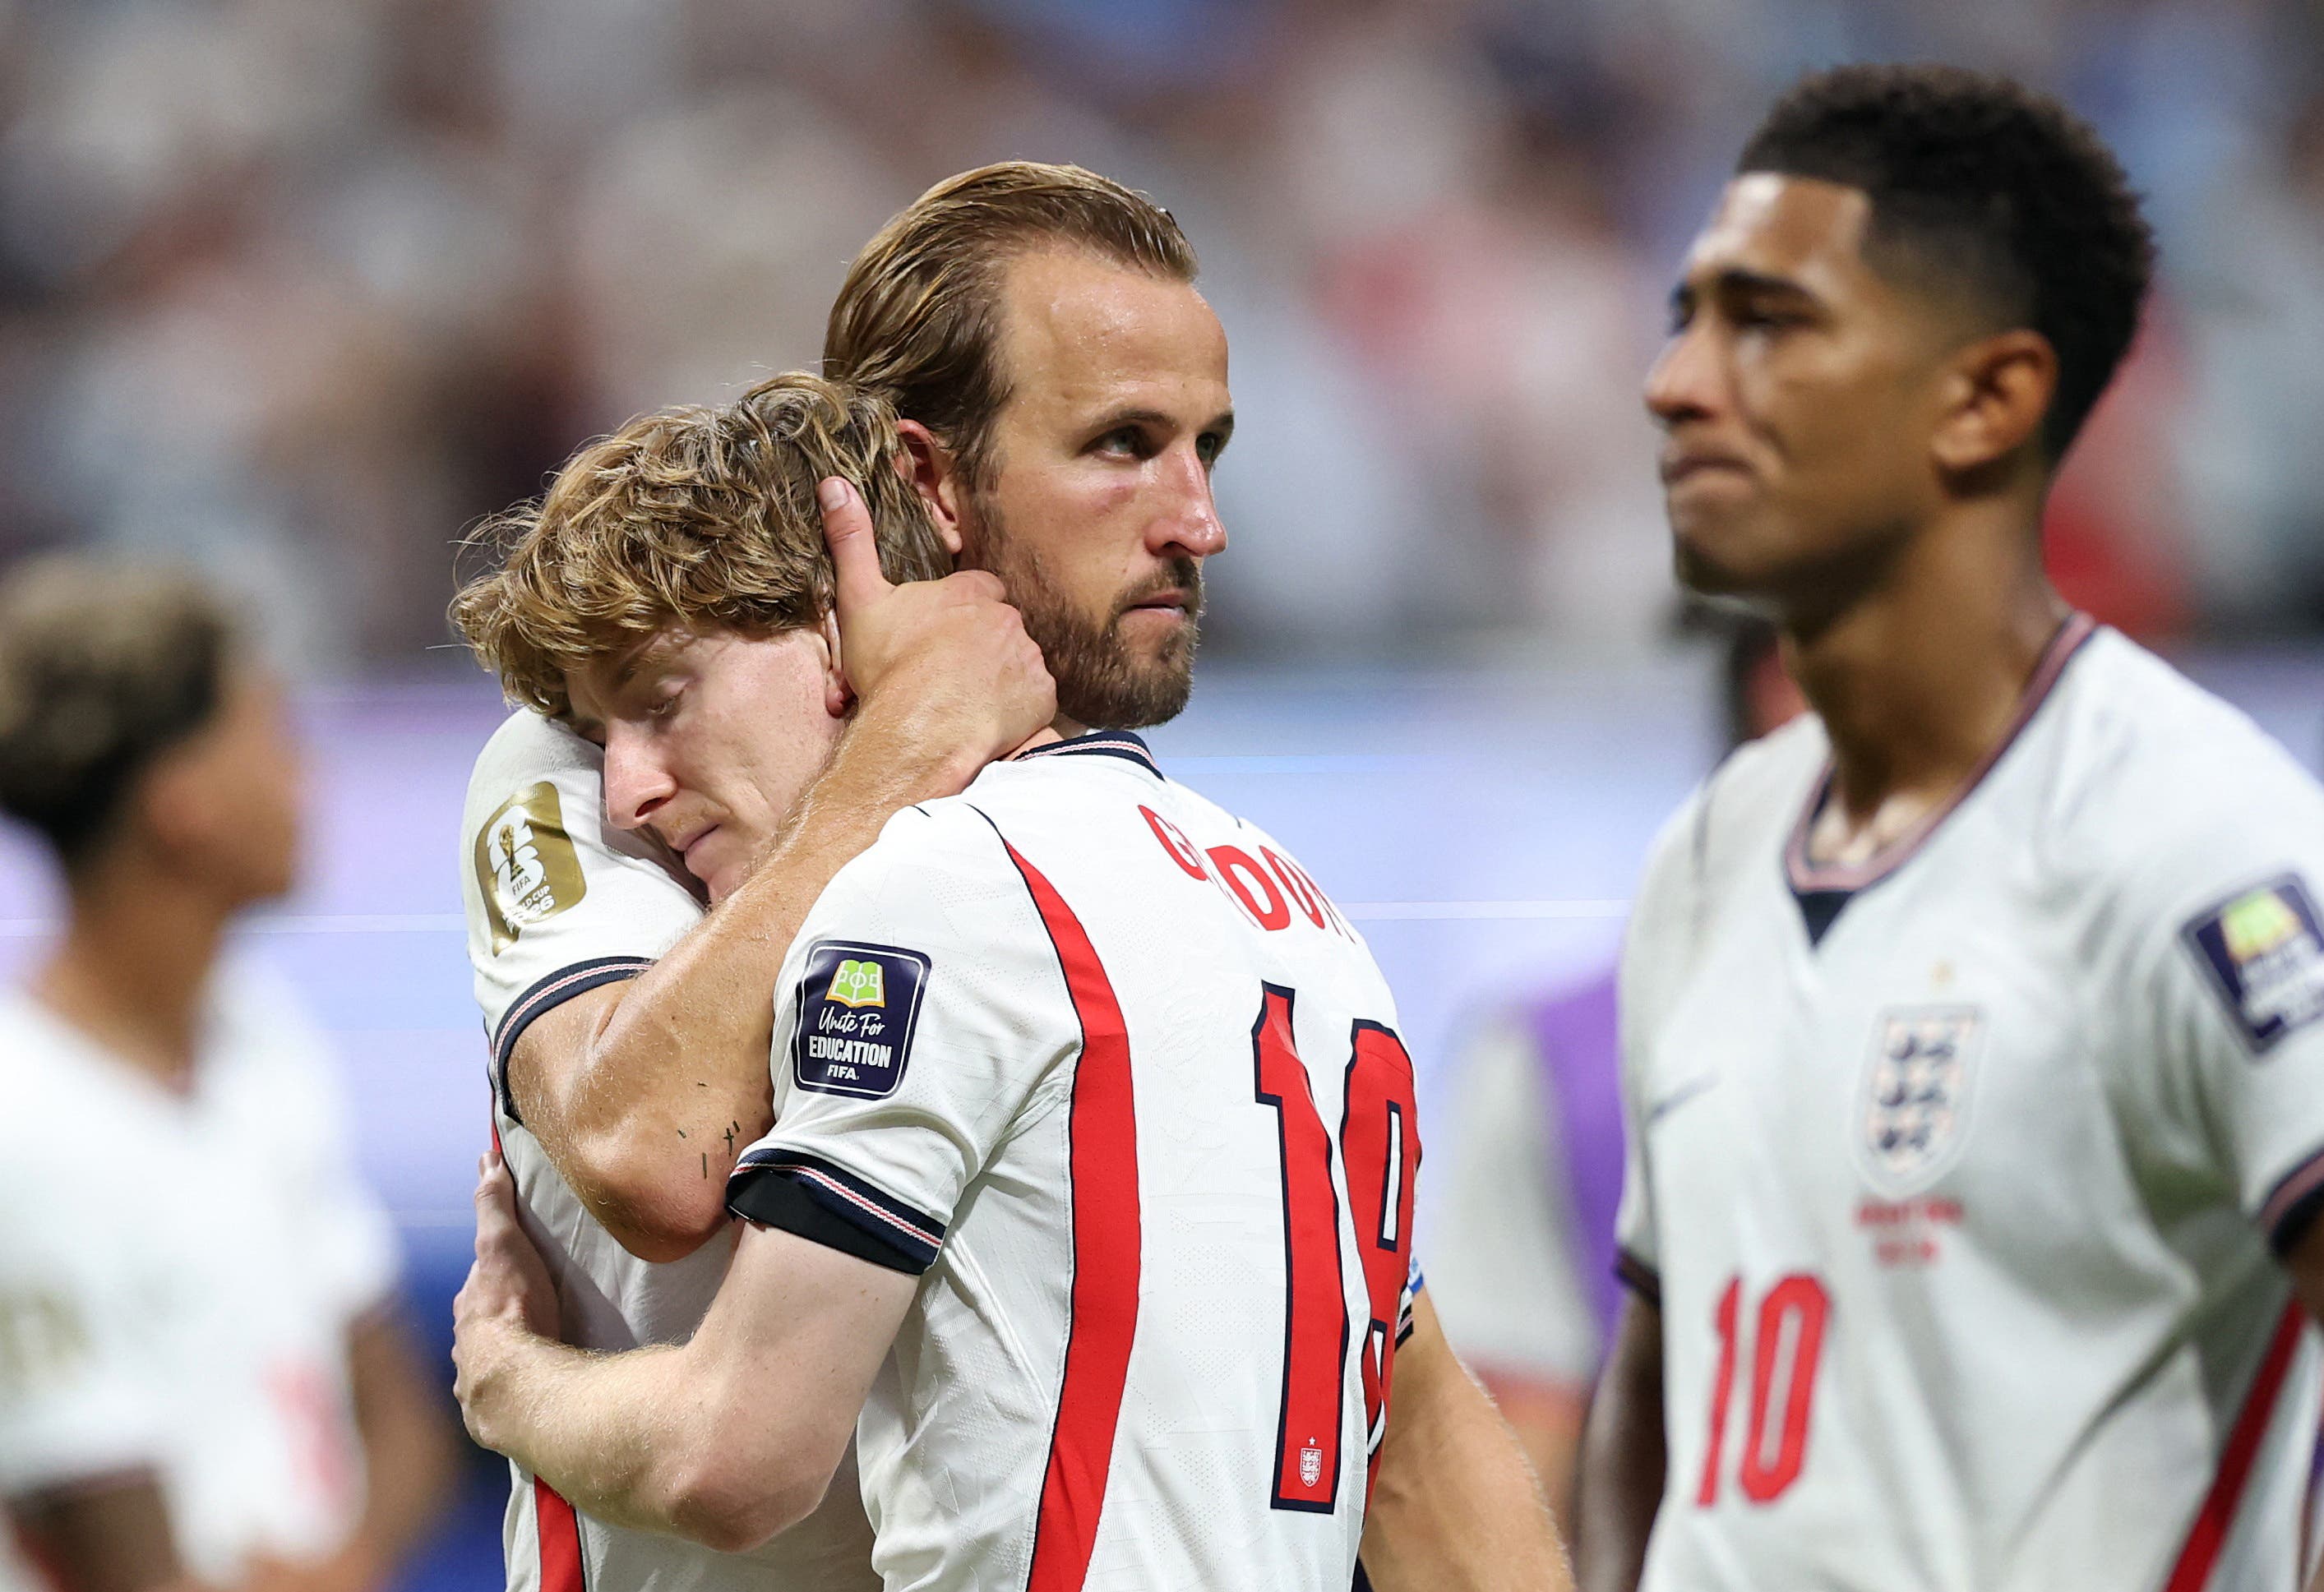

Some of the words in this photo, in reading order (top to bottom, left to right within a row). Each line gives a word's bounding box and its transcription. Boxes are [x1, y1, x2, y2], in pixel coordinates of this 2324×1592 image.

[511, 875, 531, 896] FIFA
[532, 884, 551, 902] CUP
[818, 1005, 858, 1035] Unite
[859, 1013, 886, 1038] For
[808, 1035, 893, 1069] EDUCATION
[827, 1064, 859, 1081] FIFA
[1251, 978, 1423, 1534] 18
[1695, 1271, 1833, 1507] 10
